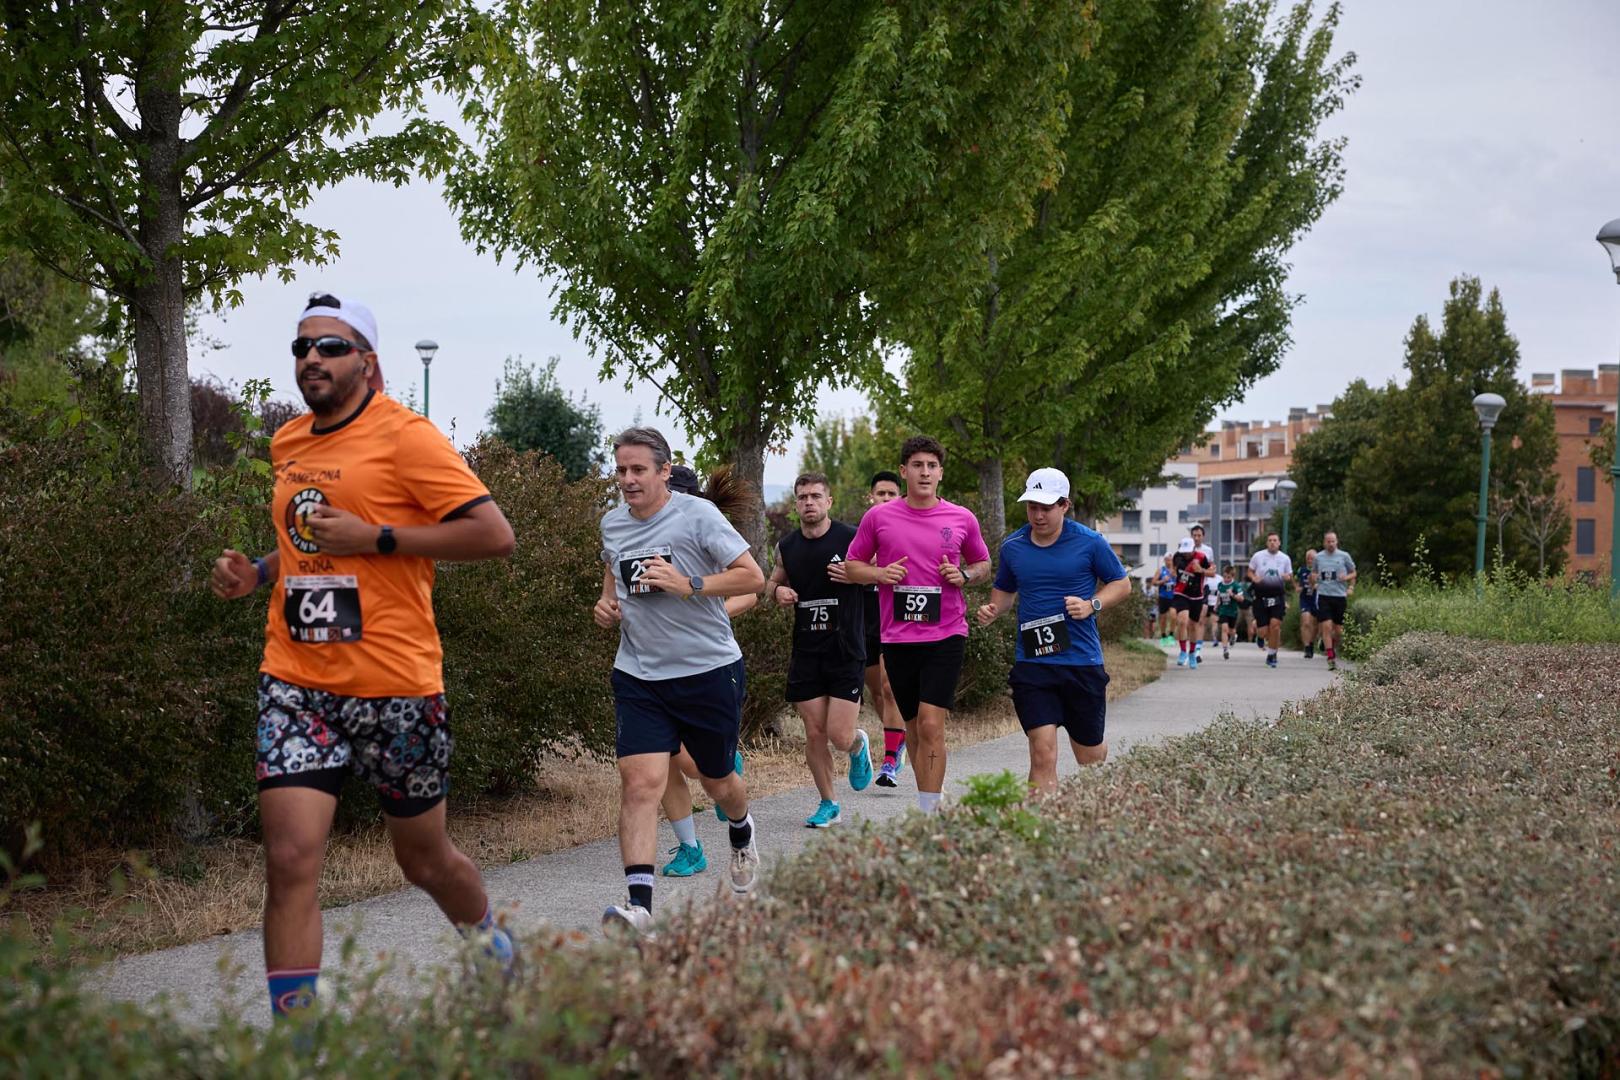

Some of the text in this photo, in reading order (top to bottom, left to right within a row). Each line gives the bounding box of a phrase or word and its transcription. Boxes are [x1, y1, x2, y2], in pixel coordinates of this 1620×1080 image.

[631, 560, 648, 582] 2
[299, 590, 337, 624] 64
[905, 594, 928, 612] 59
[810, 606, 829, 621] 75
[1034, 626, 1055, 645] 13
